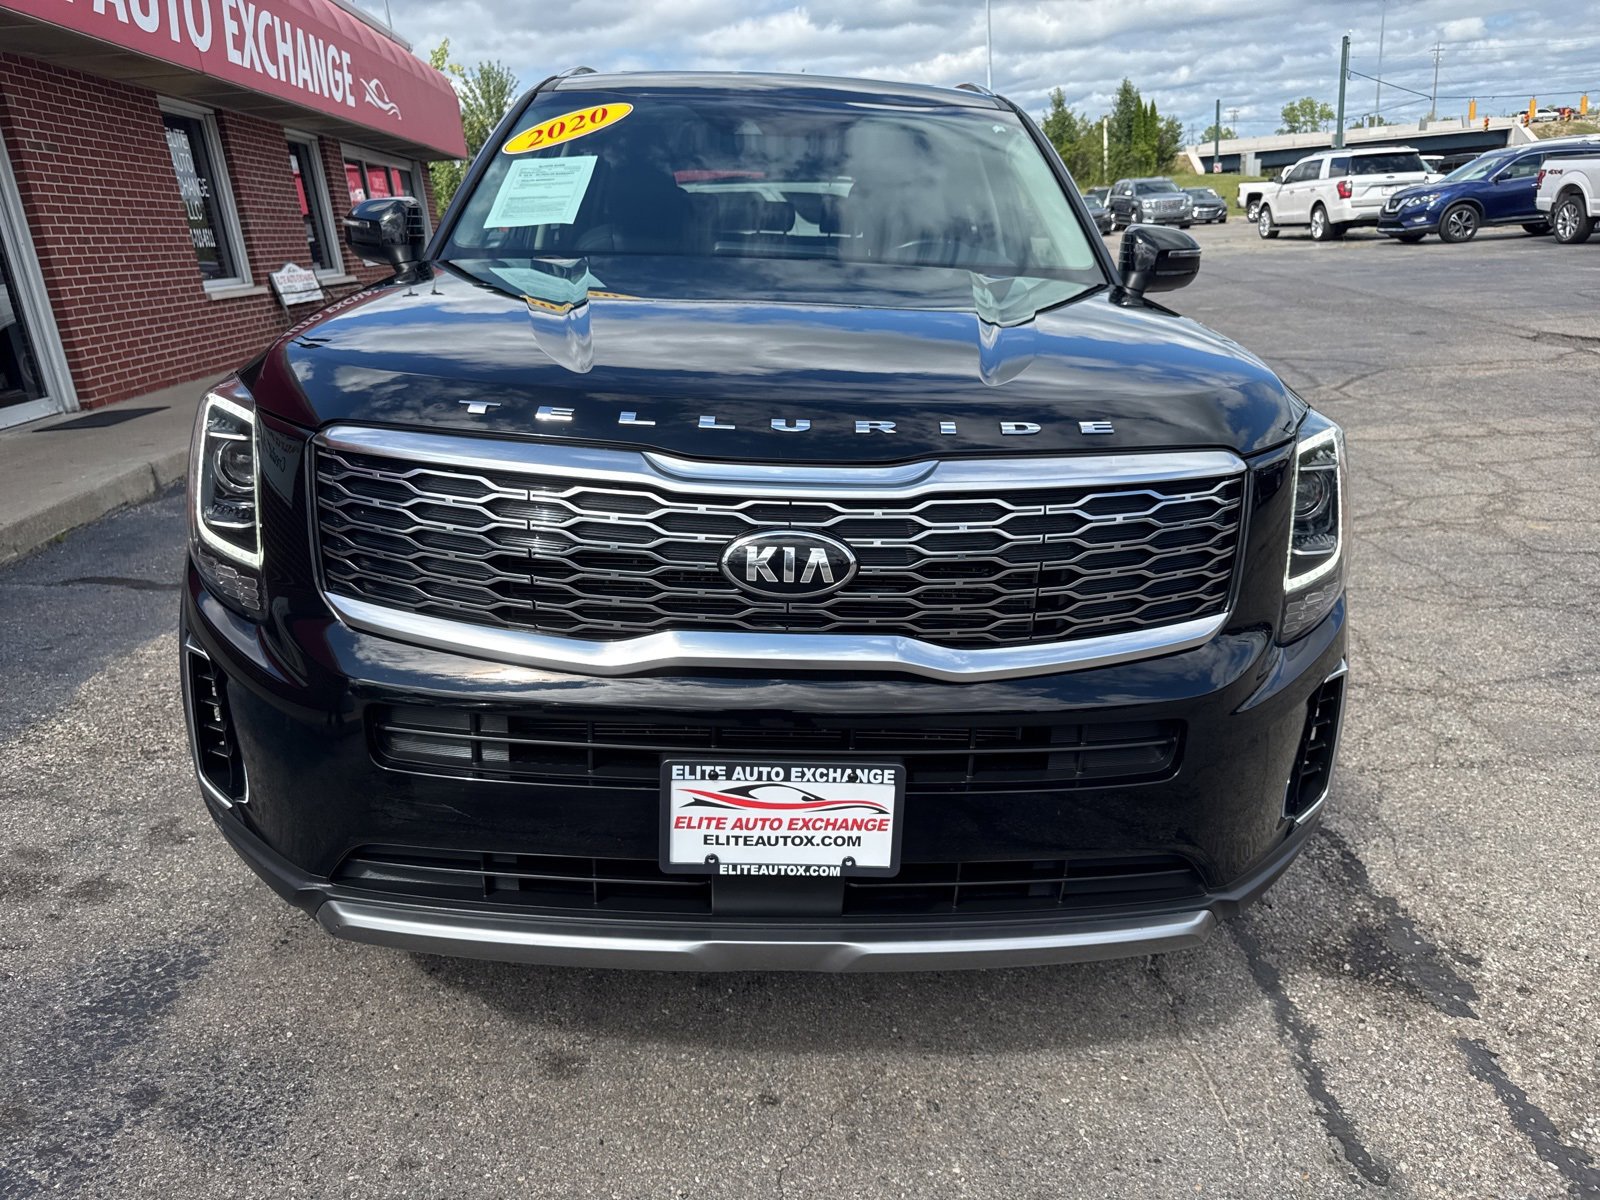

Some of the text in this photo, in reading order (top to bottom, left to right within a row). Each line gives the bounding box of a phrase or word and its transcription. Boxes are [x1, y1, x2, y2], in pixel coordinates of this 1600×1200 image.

[93, 0, 356, 107] TO EXCHANGE
[527, 107, 608, 148] 2020
[186, 200, 203, 220] LLC
[459, 400, 1114, 435] TELLURIDE
[745, 546, 835, 583] KIA
[672, 765, 895, 784] ELITE AUTO EXCHANGE
[674, 816, 890, 832] ELITE AUTO EXCHANGE
[703, 834, 862, 847] ELITEAUTOX.COM
[719, 864, 841, 877] ELITEAUTOX.COM
